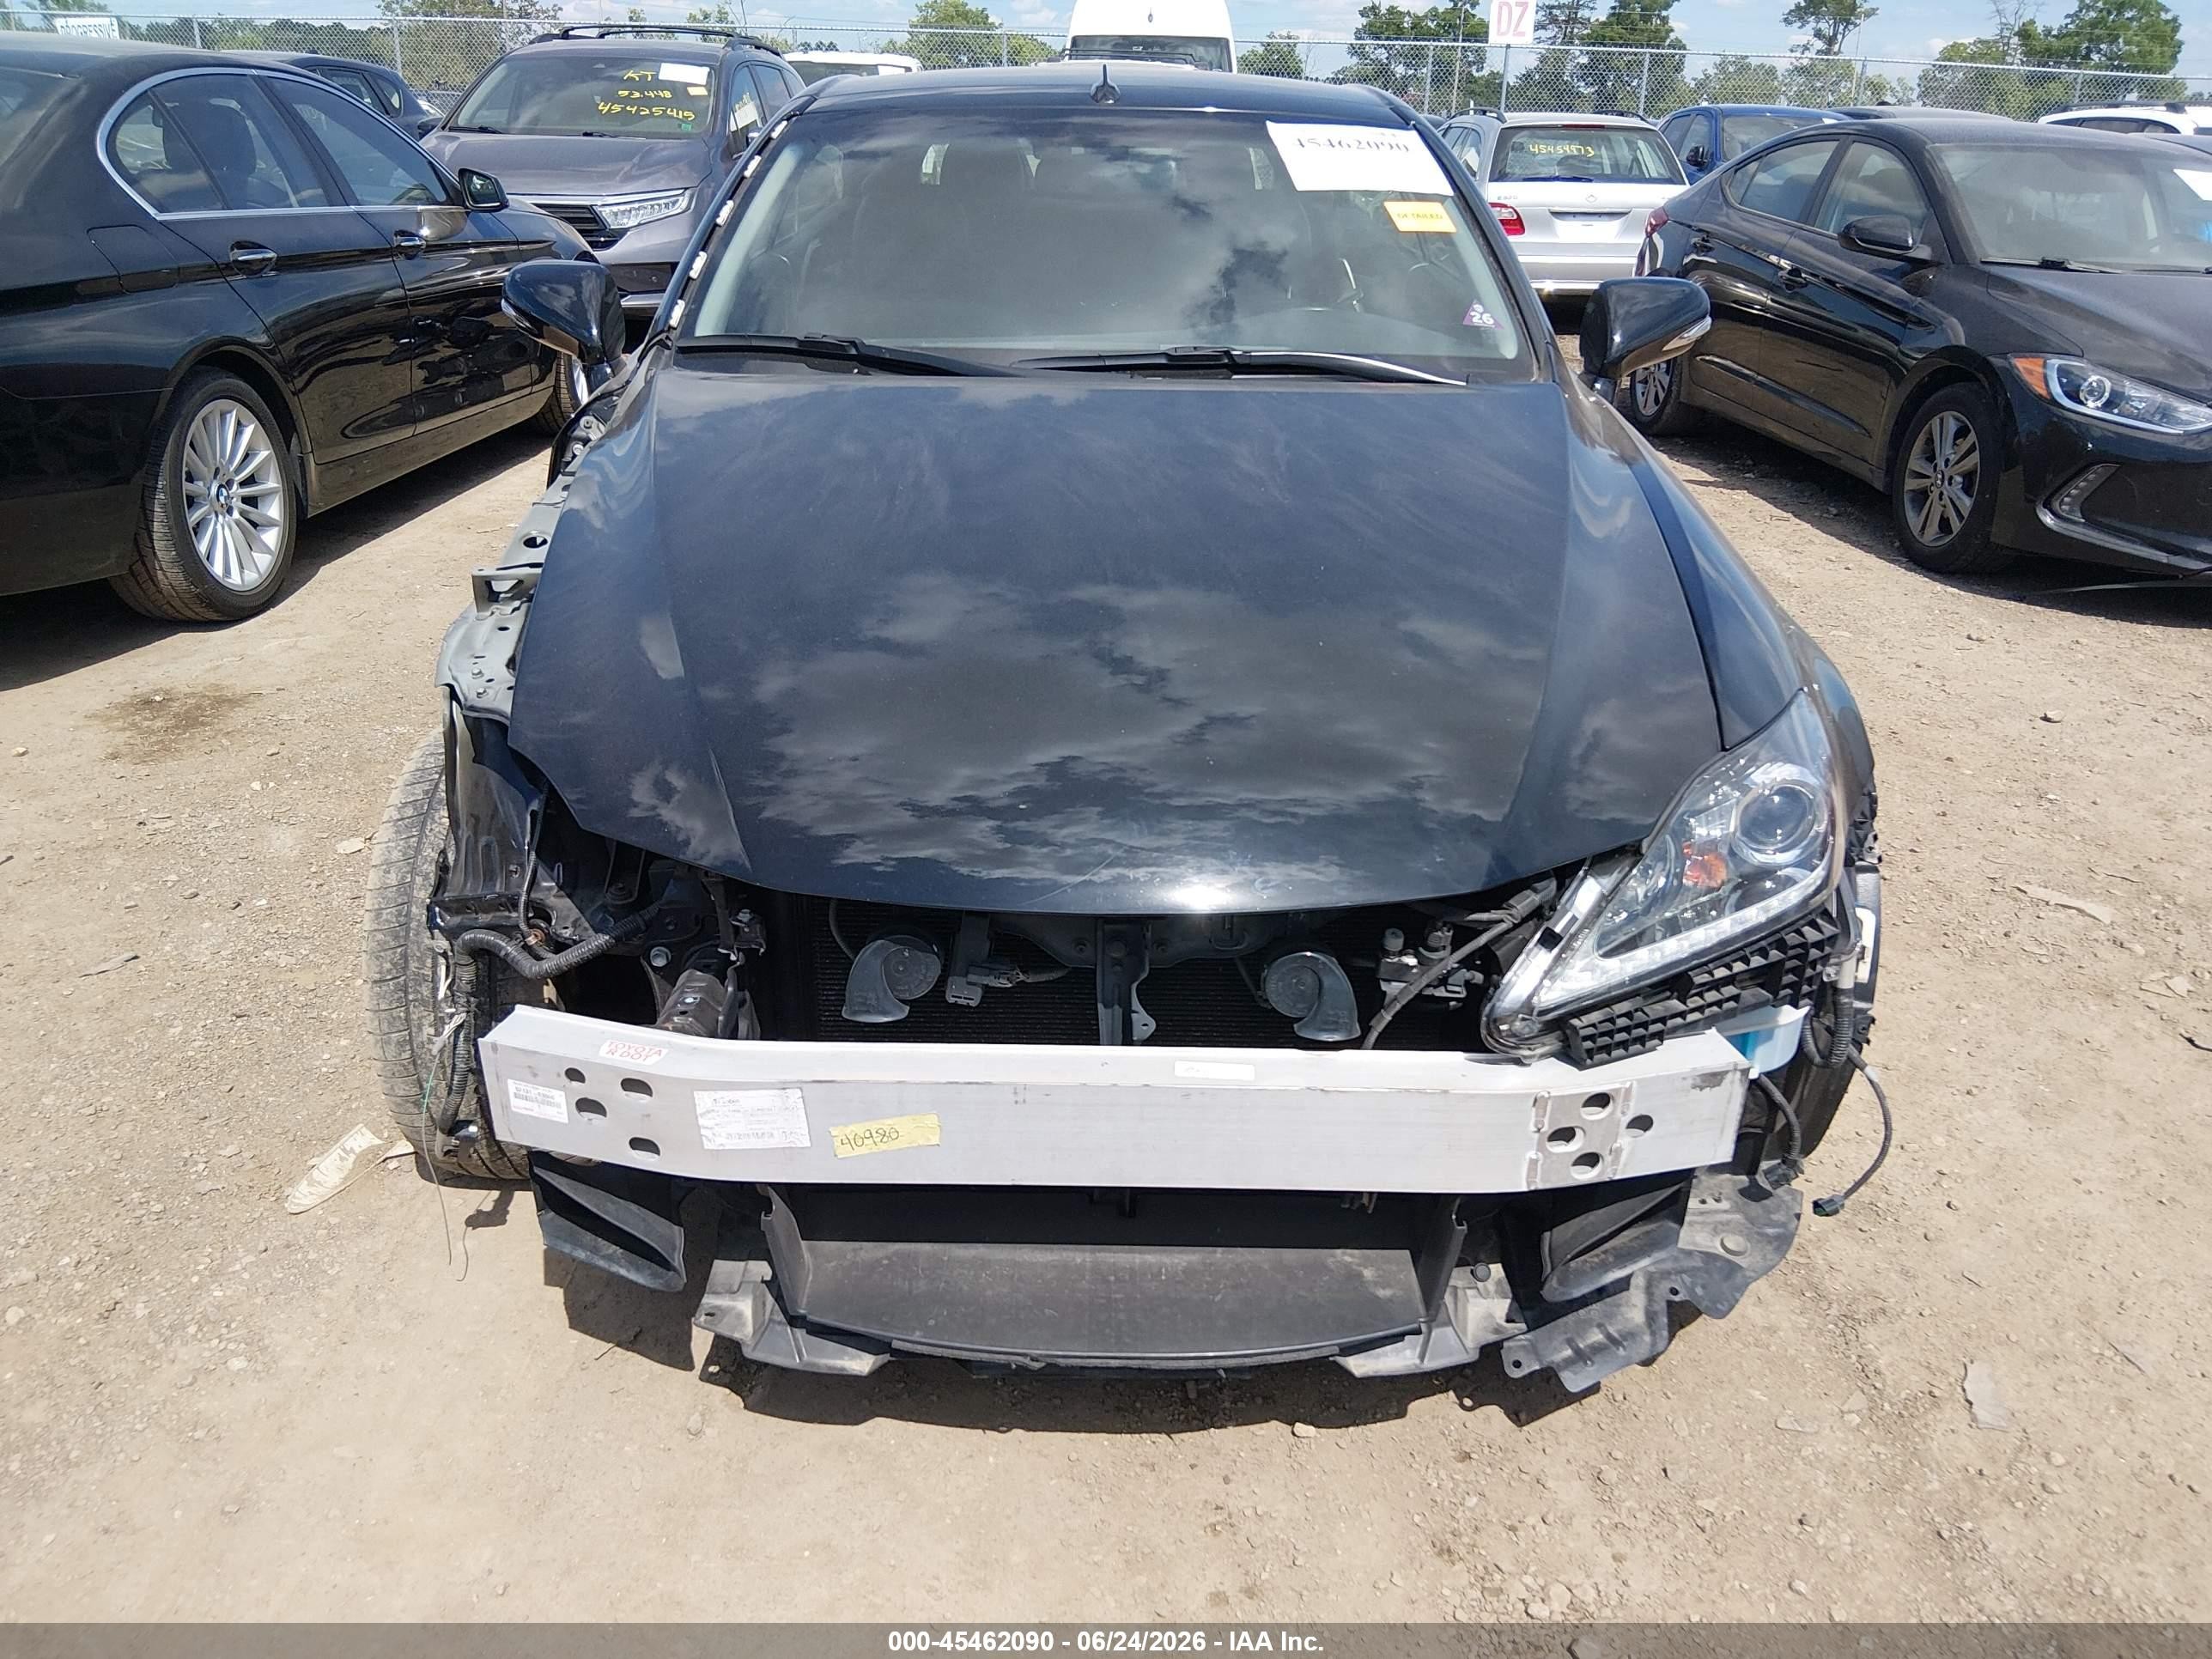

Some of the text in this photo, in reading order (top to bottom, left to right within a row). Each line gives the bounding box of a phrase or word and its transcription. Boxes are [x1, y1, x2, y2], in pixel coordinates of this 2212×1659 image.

[1497, 1, 1528, 37] DZ
[1469, 311, 1494, 325] 26
[607, 1042, 662, 1057] TOYOTA
[840, 1127, 900, 1152] 40980
